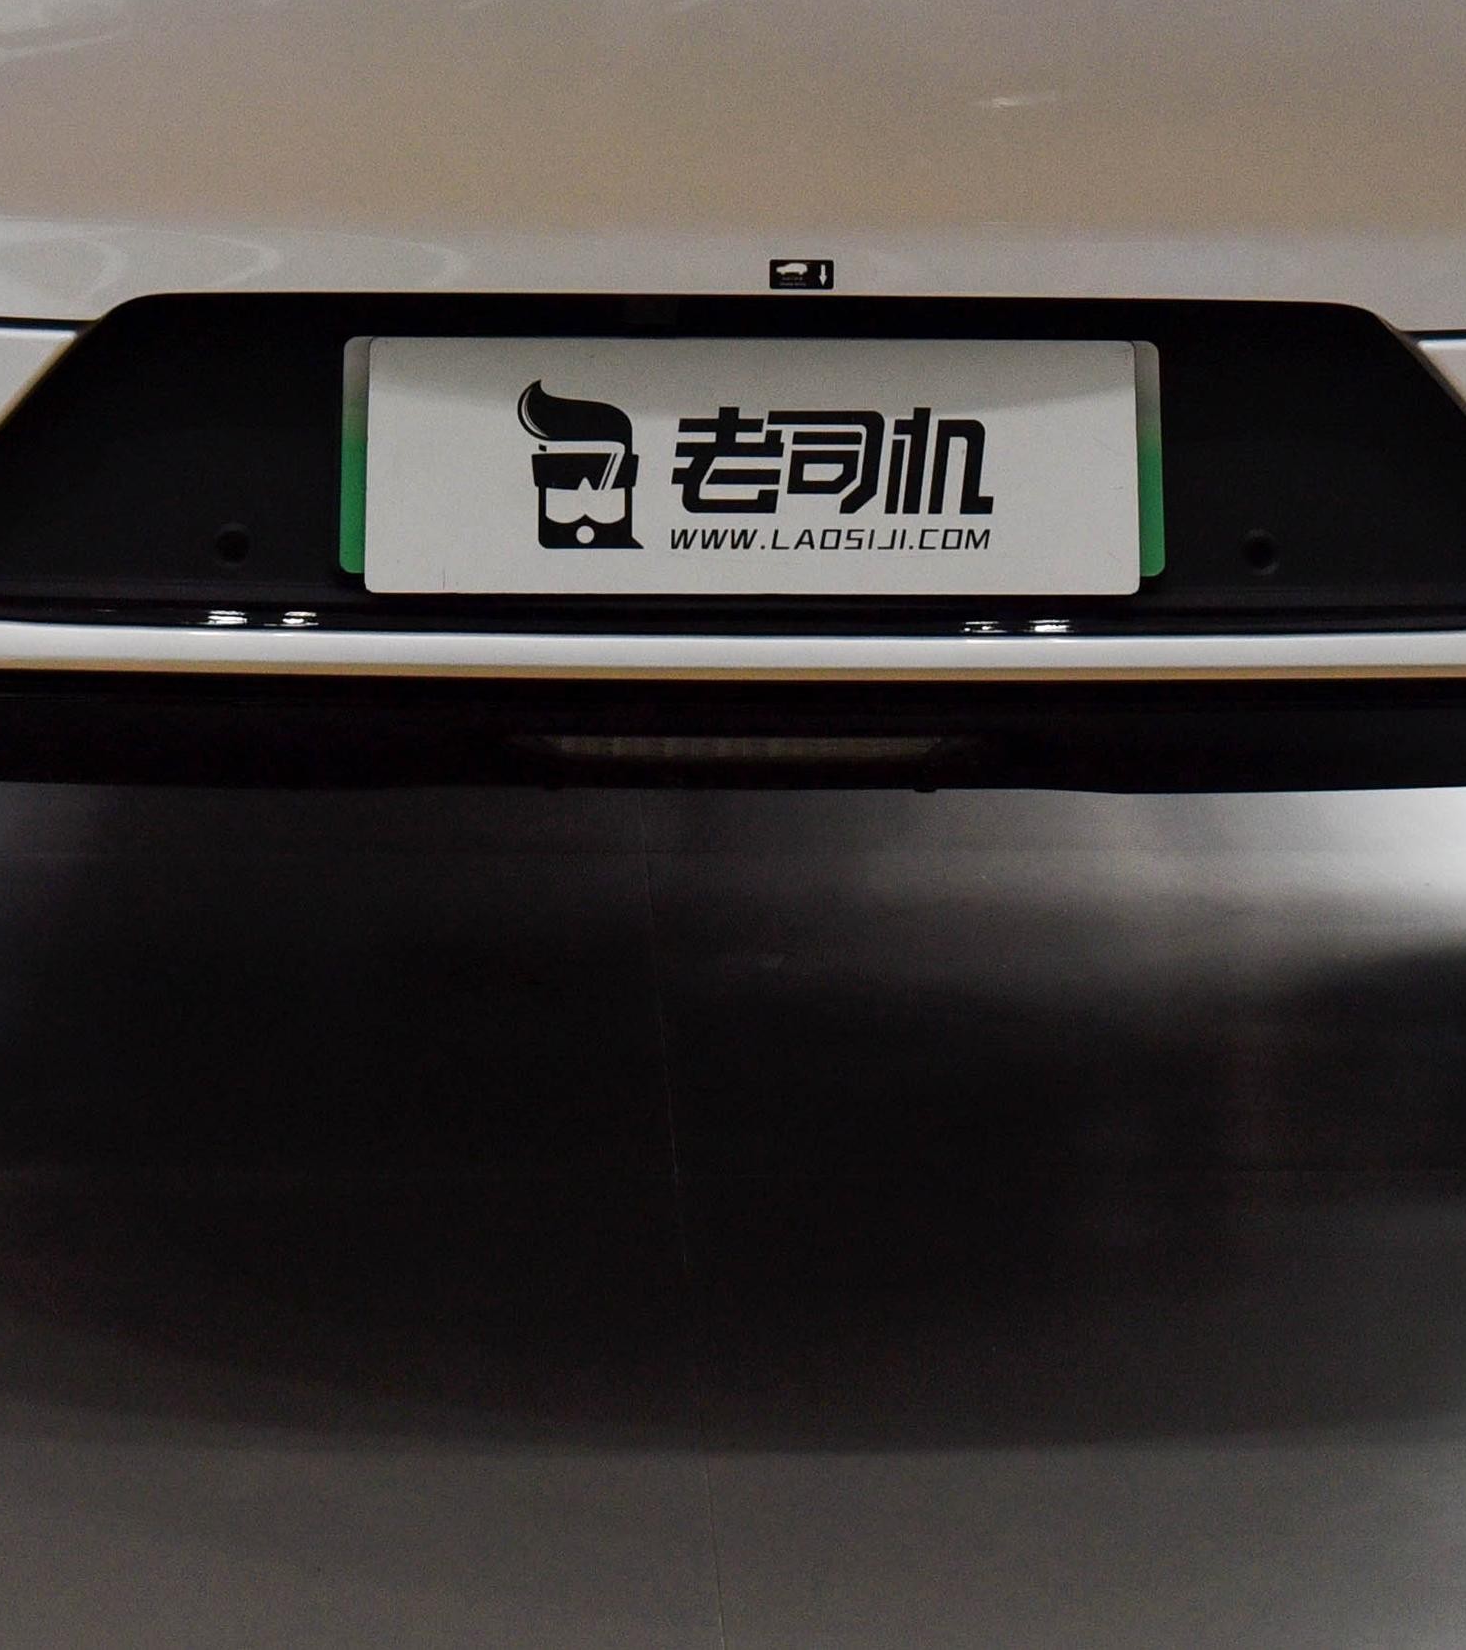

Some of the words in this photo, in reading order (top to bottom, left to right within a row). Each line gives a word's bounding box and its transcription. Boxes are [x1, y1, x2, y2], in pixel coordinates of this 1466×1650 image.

[671, 406, 994, 515] 老司机
[669, 528, 991, 551] WWW.LAOSIJI.COM
